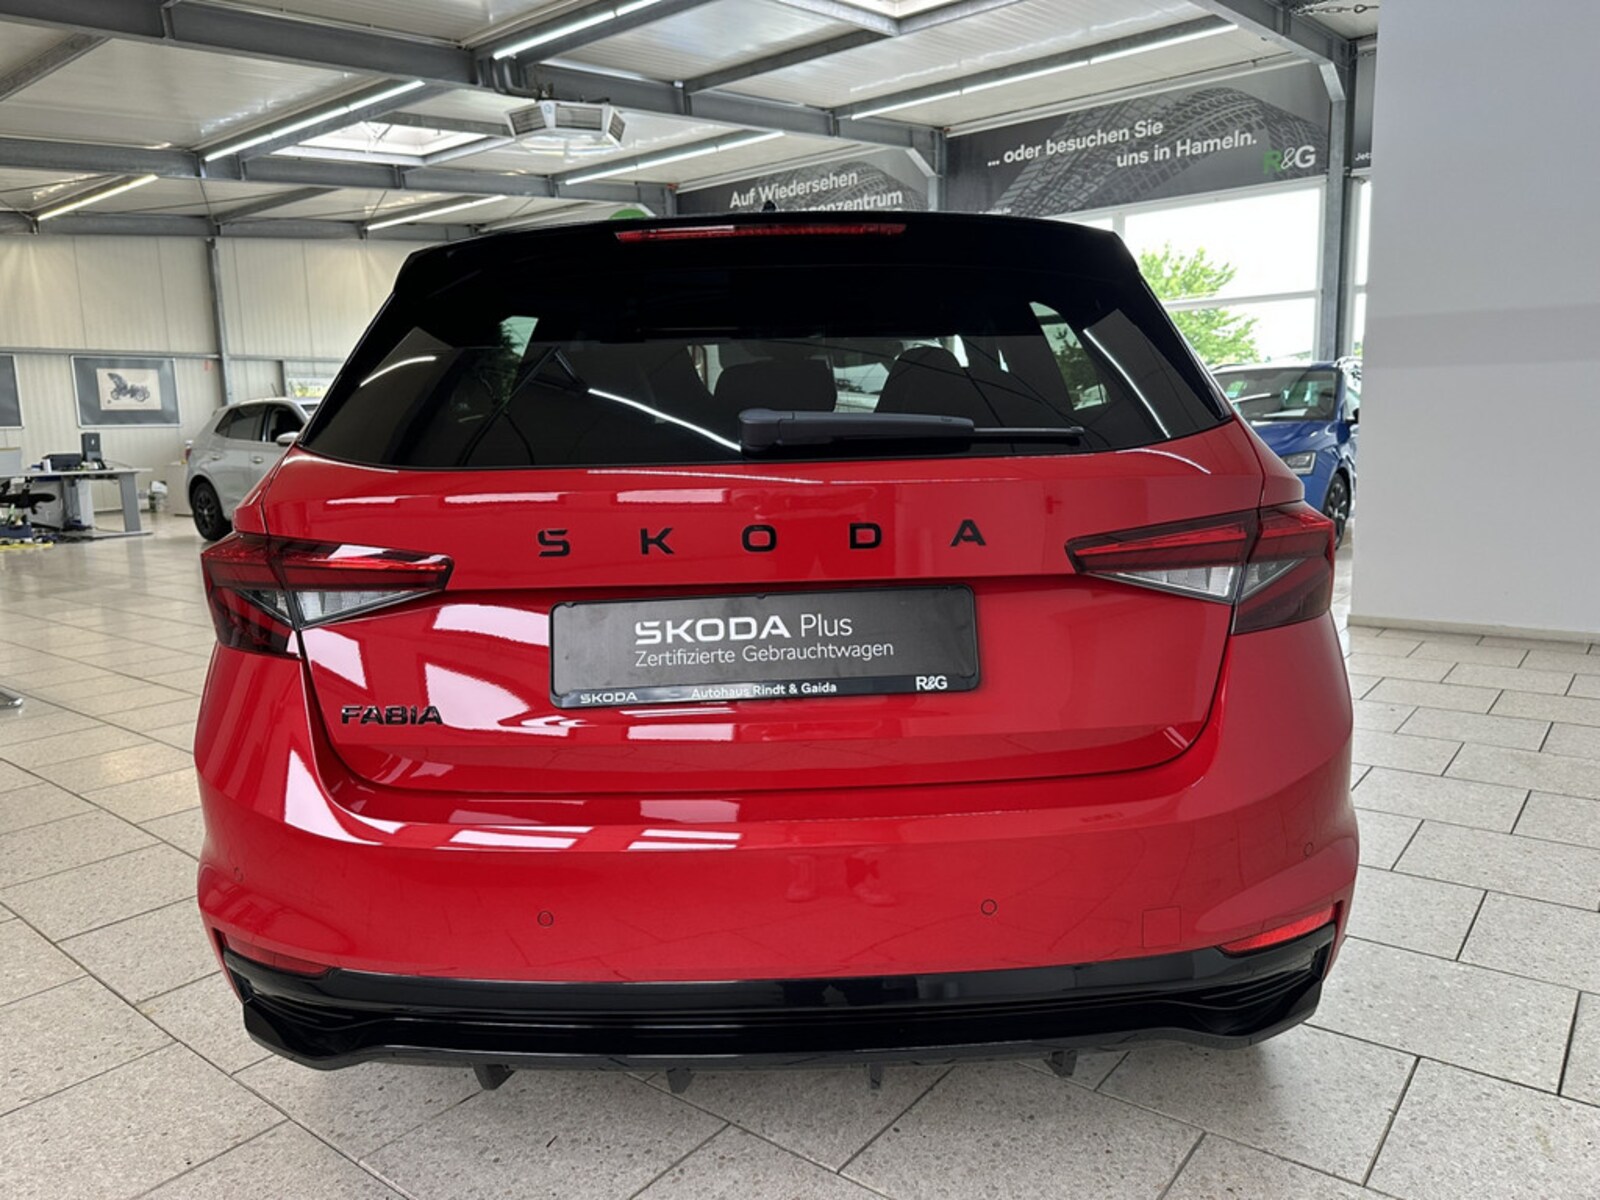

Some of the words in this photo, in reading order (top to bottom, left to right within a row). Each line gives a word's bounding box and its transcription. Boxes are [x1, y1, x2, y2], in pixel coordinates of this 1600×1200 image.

[1003, 144, 1042, 164] oder
[1045, 127, 1130, 156] besuchen
[1133, 119, 1164, 139] Sie
[1116, 148, 1149, 168] uns
[1153, 145, 1171, 162] in
[1175, 130, 1258, 158] Hameln.
[1263, 145, 1316, 175] R&G
[729, 190, 756, 209] Auf
[758, 171, 859, 202] Wiedersehen
[800, 613, 853, 637] Plus
[635, 648, 736, 667] Zertifizierte
[742, 641, 894, 664] Gebrauchtwagen
[691, 686, 750, 699] Autohaus
[752, 683, 786, 696] Rindt
[789, 683, 798, 694] &
[801, 681, 837, 694] Gaida
[916, 675, 947, 690] R&G
[341, 705, 443, 725] FABIA
